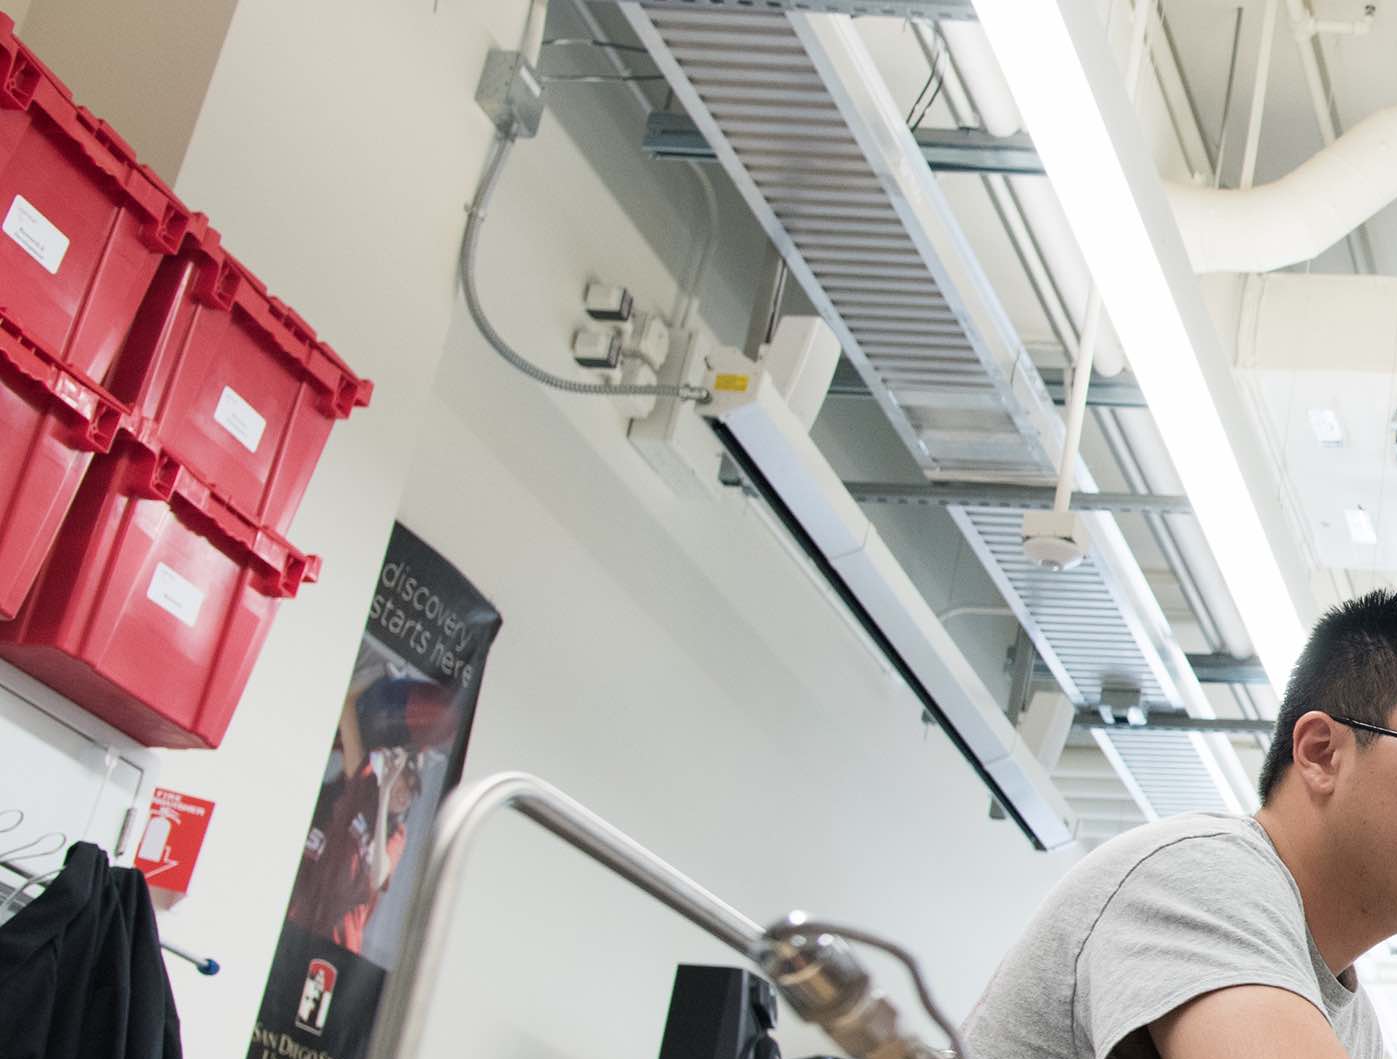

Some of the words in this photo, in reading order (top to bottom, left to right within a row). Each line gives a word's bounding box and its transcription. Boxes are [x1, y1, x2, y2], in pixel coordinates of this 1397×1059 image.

[369, 594, 431, 655] starts
[430, 636, 473, 688] here
[382, 562, 472, 652] discovery
